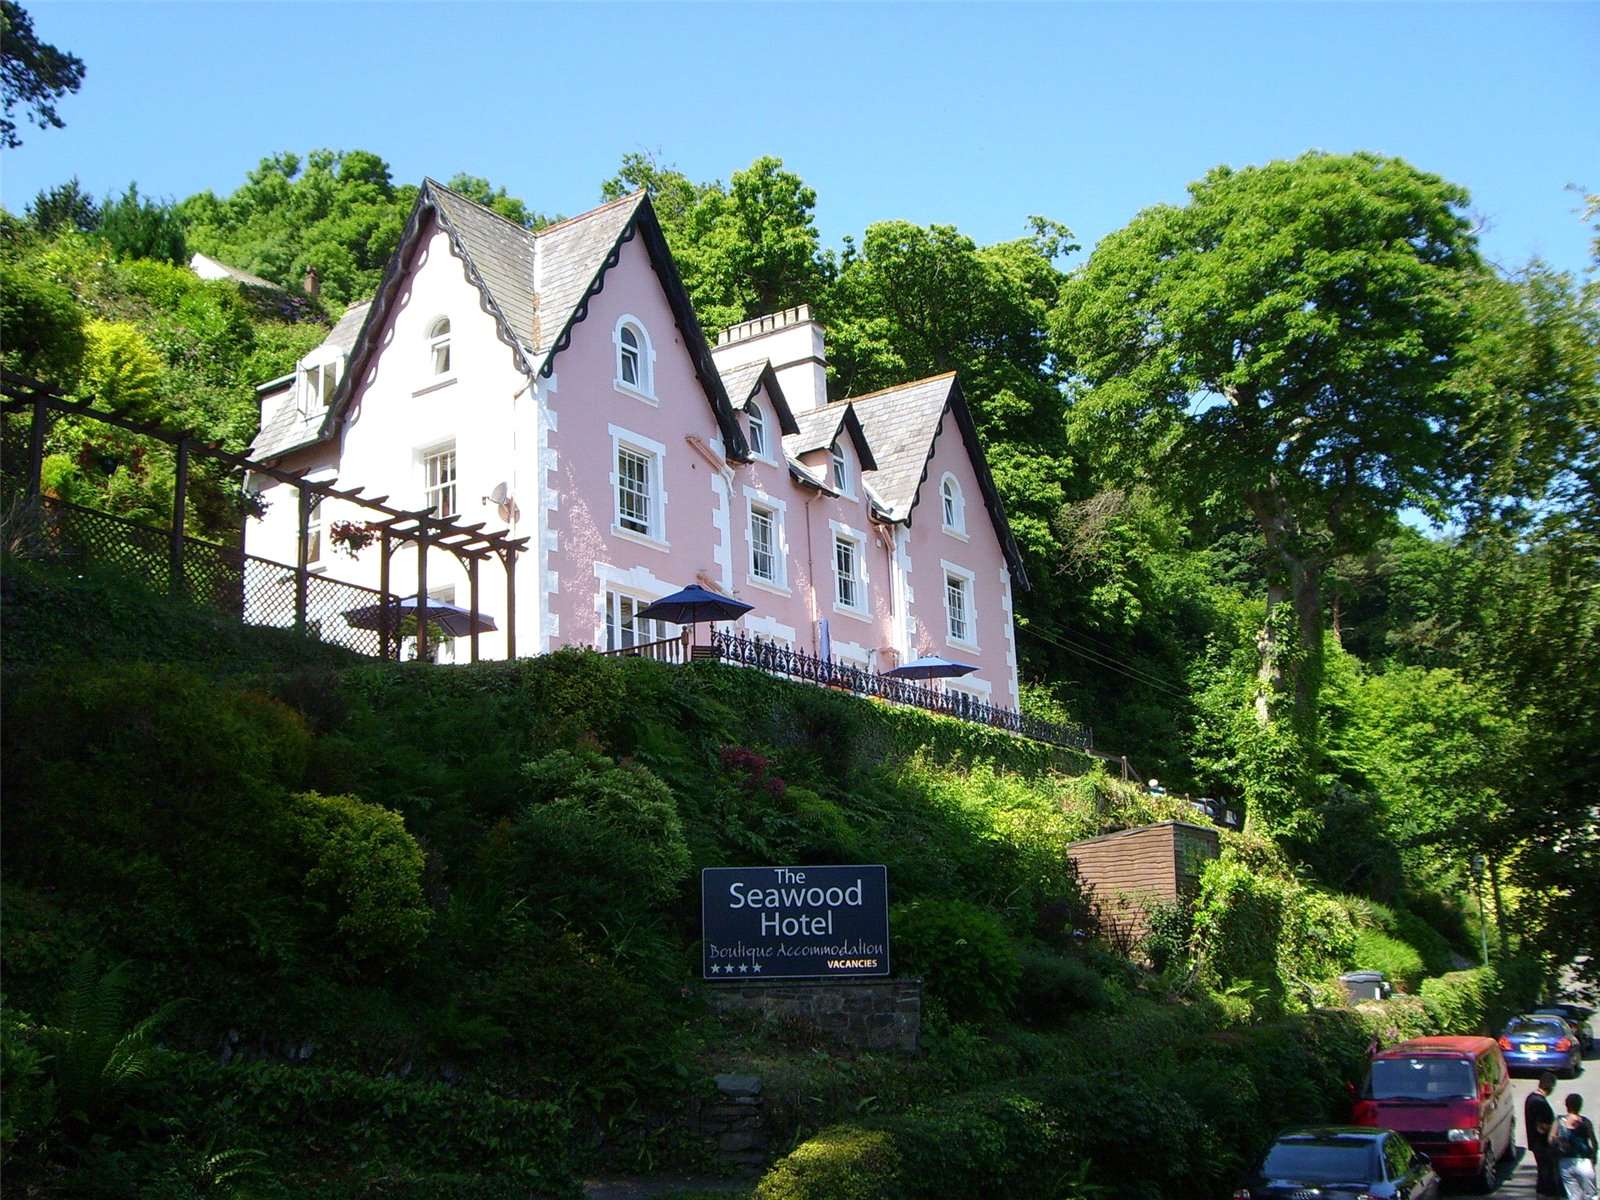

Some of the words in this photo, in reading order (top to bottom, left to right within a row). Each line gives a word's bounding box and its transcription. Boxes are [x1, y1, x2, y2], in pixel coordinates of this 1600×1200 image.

[774, 869, 806, 884] The
[729, 879, 863, 908] Seawood
[761, 910, 833, 936] Hotel
[710, 941, 774, 964] Boutique
[776, 939, 883, 957] Accommodation
[827, 959, 878, 969] VACANCIES
